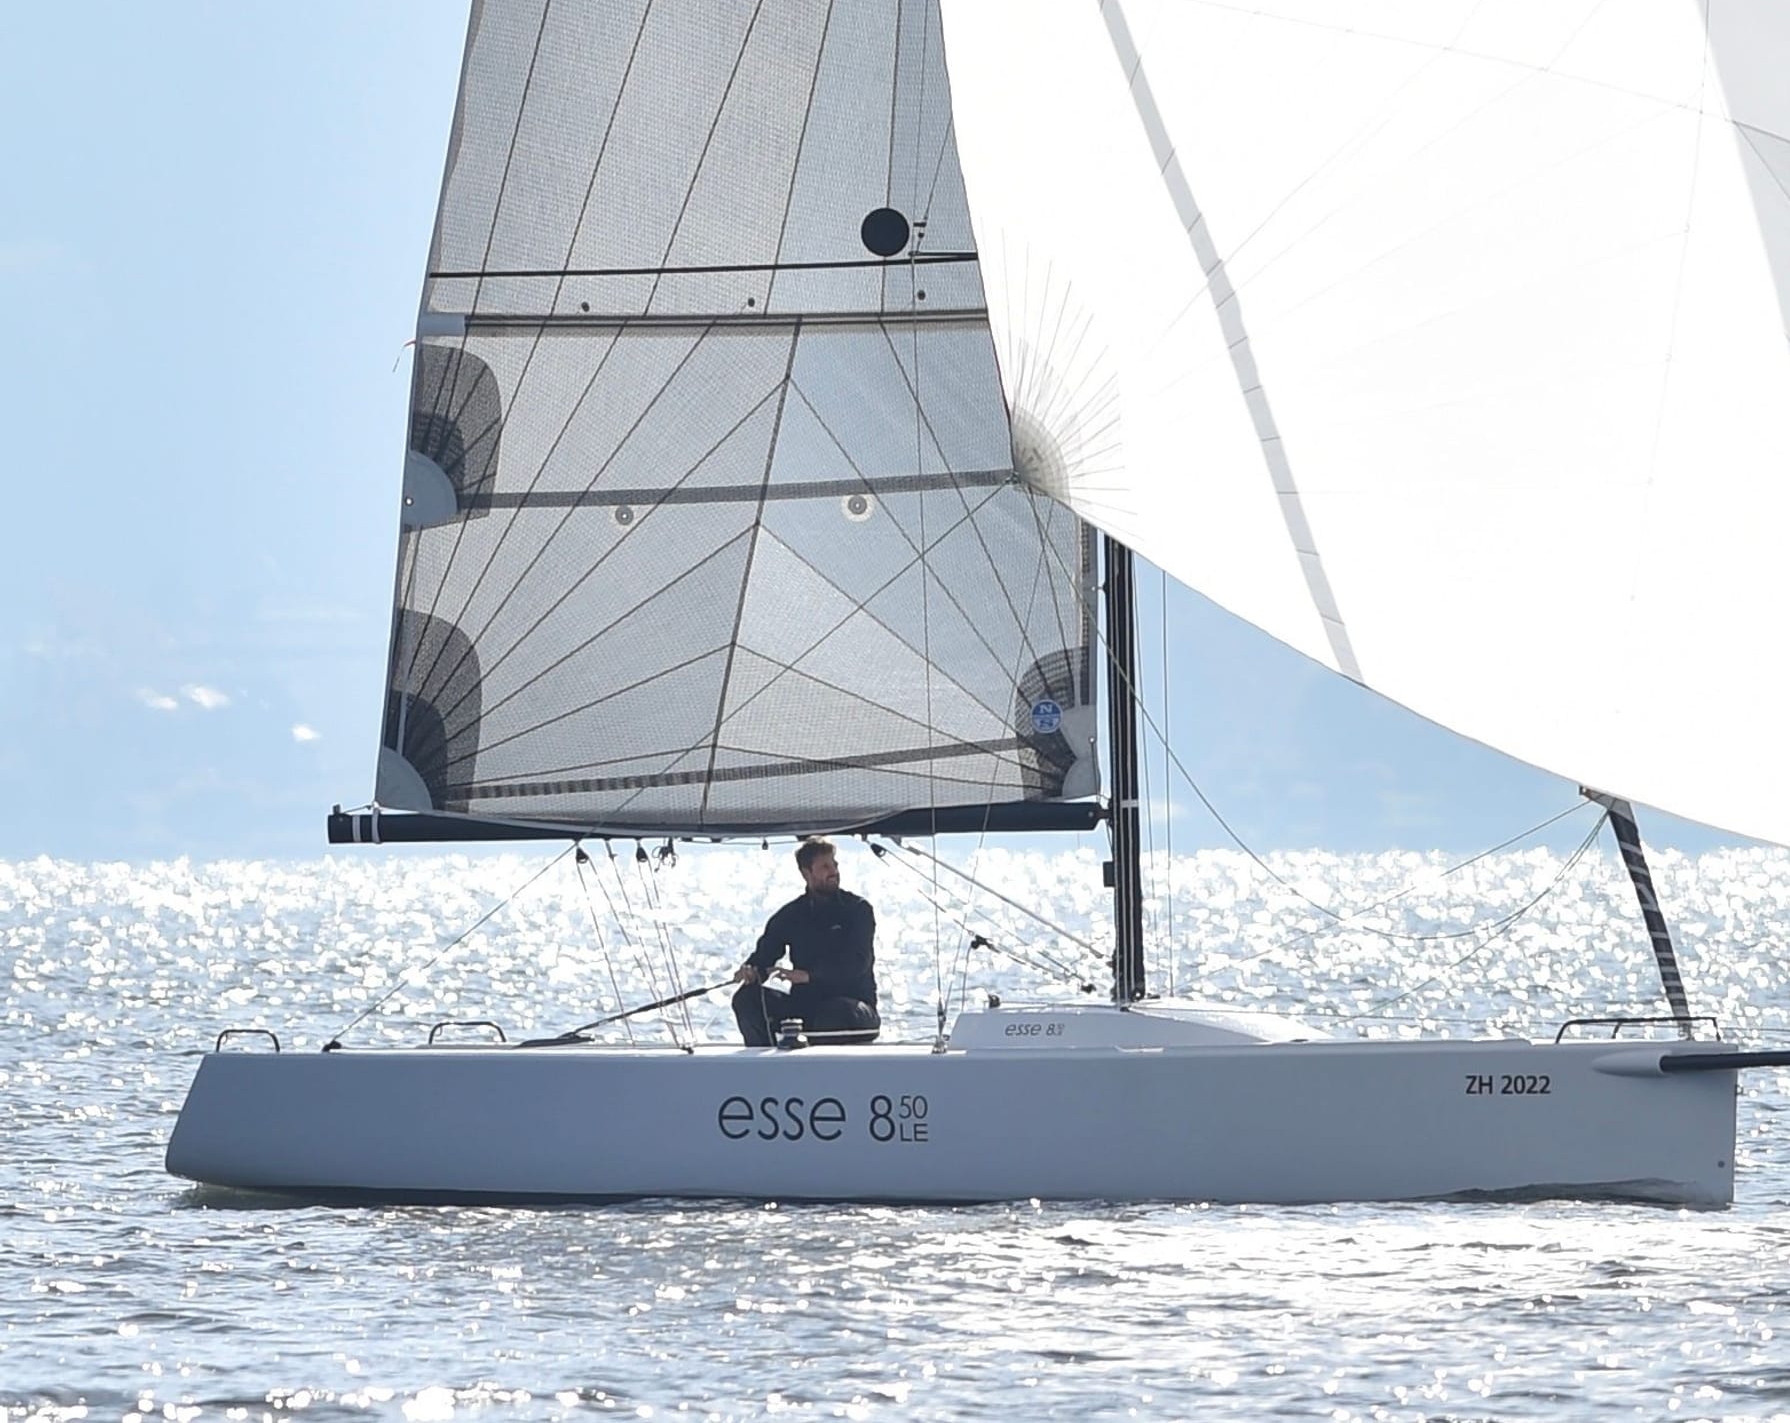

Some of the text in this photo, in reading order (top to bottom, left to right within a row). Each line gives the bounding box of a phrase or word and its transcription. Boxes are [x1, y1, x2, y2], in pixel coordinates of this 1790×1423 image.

[1004, 1023, 1042, 1037] esse
[1465, 1075, 1551, 1095] ZH 2022
[717, 1095, 847, 1141] esse
